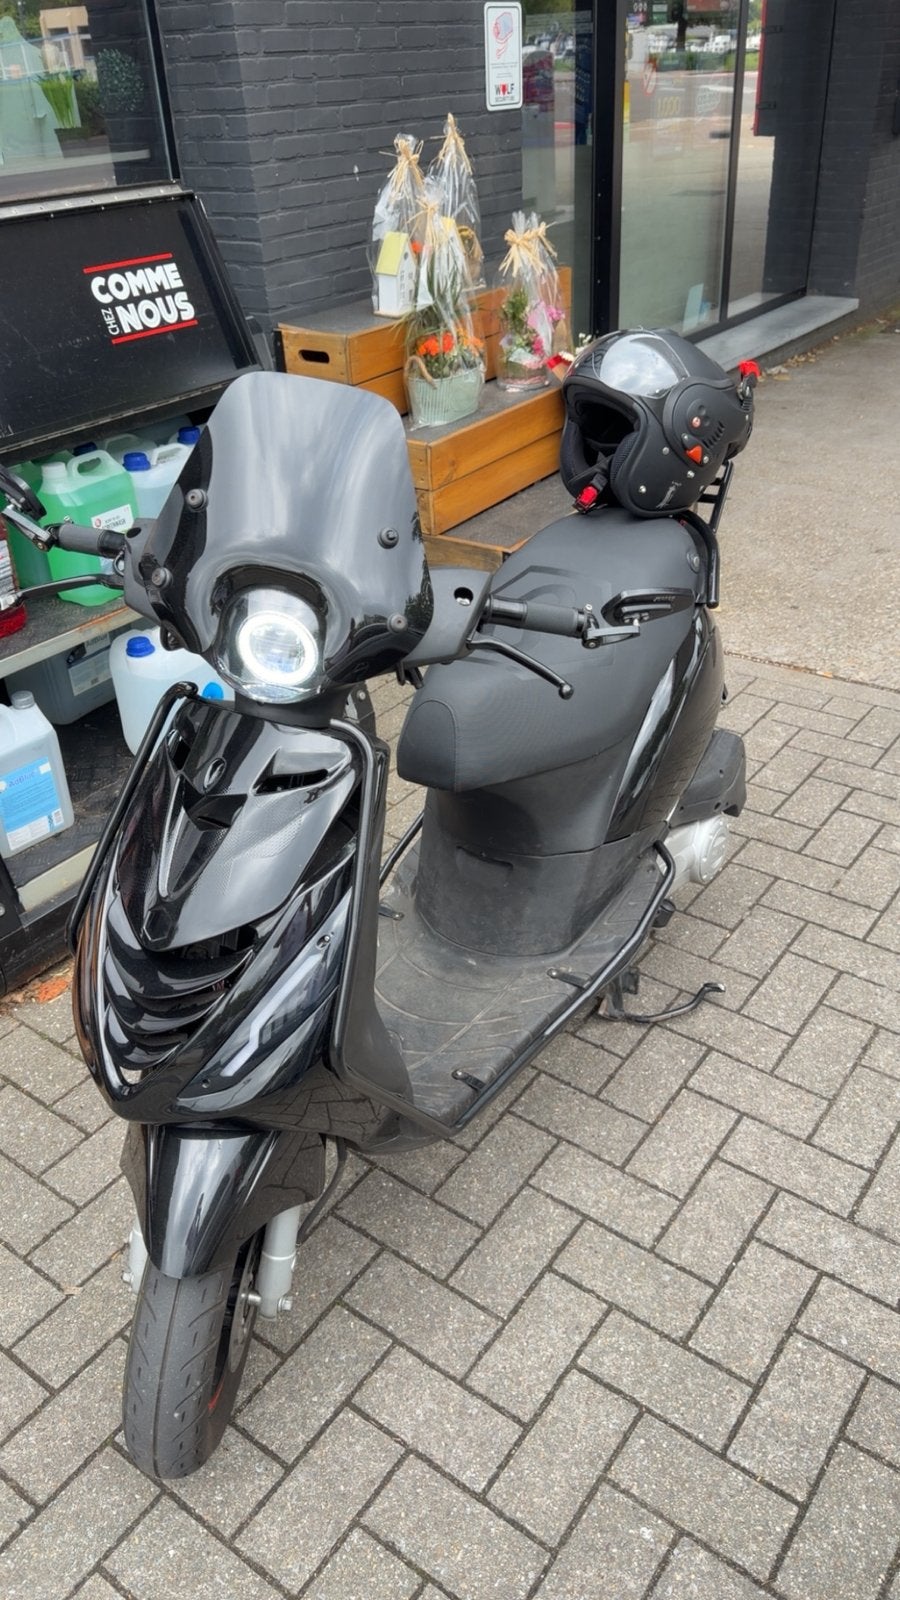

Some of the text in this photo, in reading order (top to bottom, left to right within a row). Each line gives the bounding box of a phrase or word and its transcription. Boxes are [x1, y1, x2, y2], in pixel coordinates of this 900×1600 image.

[91, 263, 184, 304] COMME
[101, 307, 120, 335] CHEZ
[115, 291, 195, 333] NOUS
